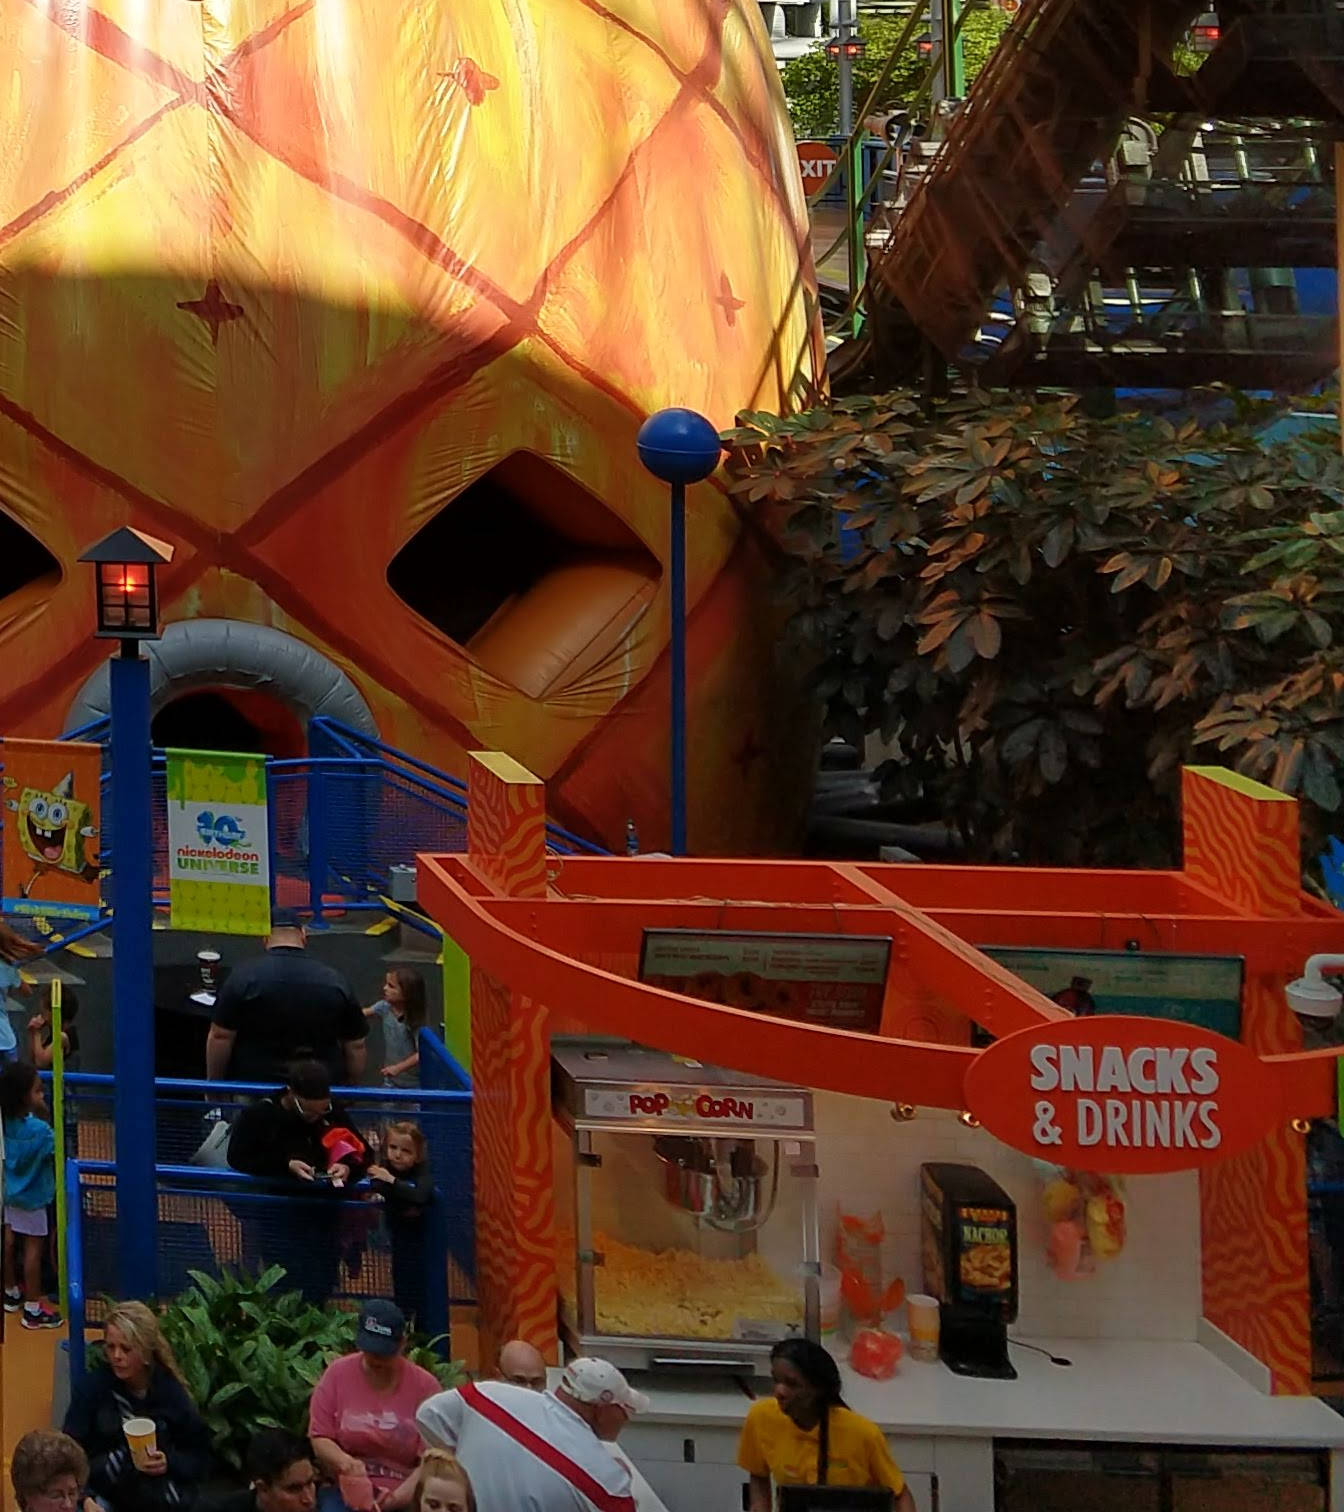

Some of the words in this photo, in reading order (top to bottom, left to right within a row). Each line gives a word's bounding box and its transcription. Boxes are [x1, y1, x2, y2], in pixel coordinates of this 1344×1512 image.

[800, 159, 837, 178] XIT
[177, 844, 259, 862] nickelodeon
[176, 856, 260, 875] UNIVERSE
[1030, 1044, 1219, 1094] SNACKS
[629, 1093, 669, 1117] POP
[696, 1093, 754, 1120] CORN
[1033, 1099, 1062, 1146] &
[1077, 1099, 1221, 1149] DRINKS
